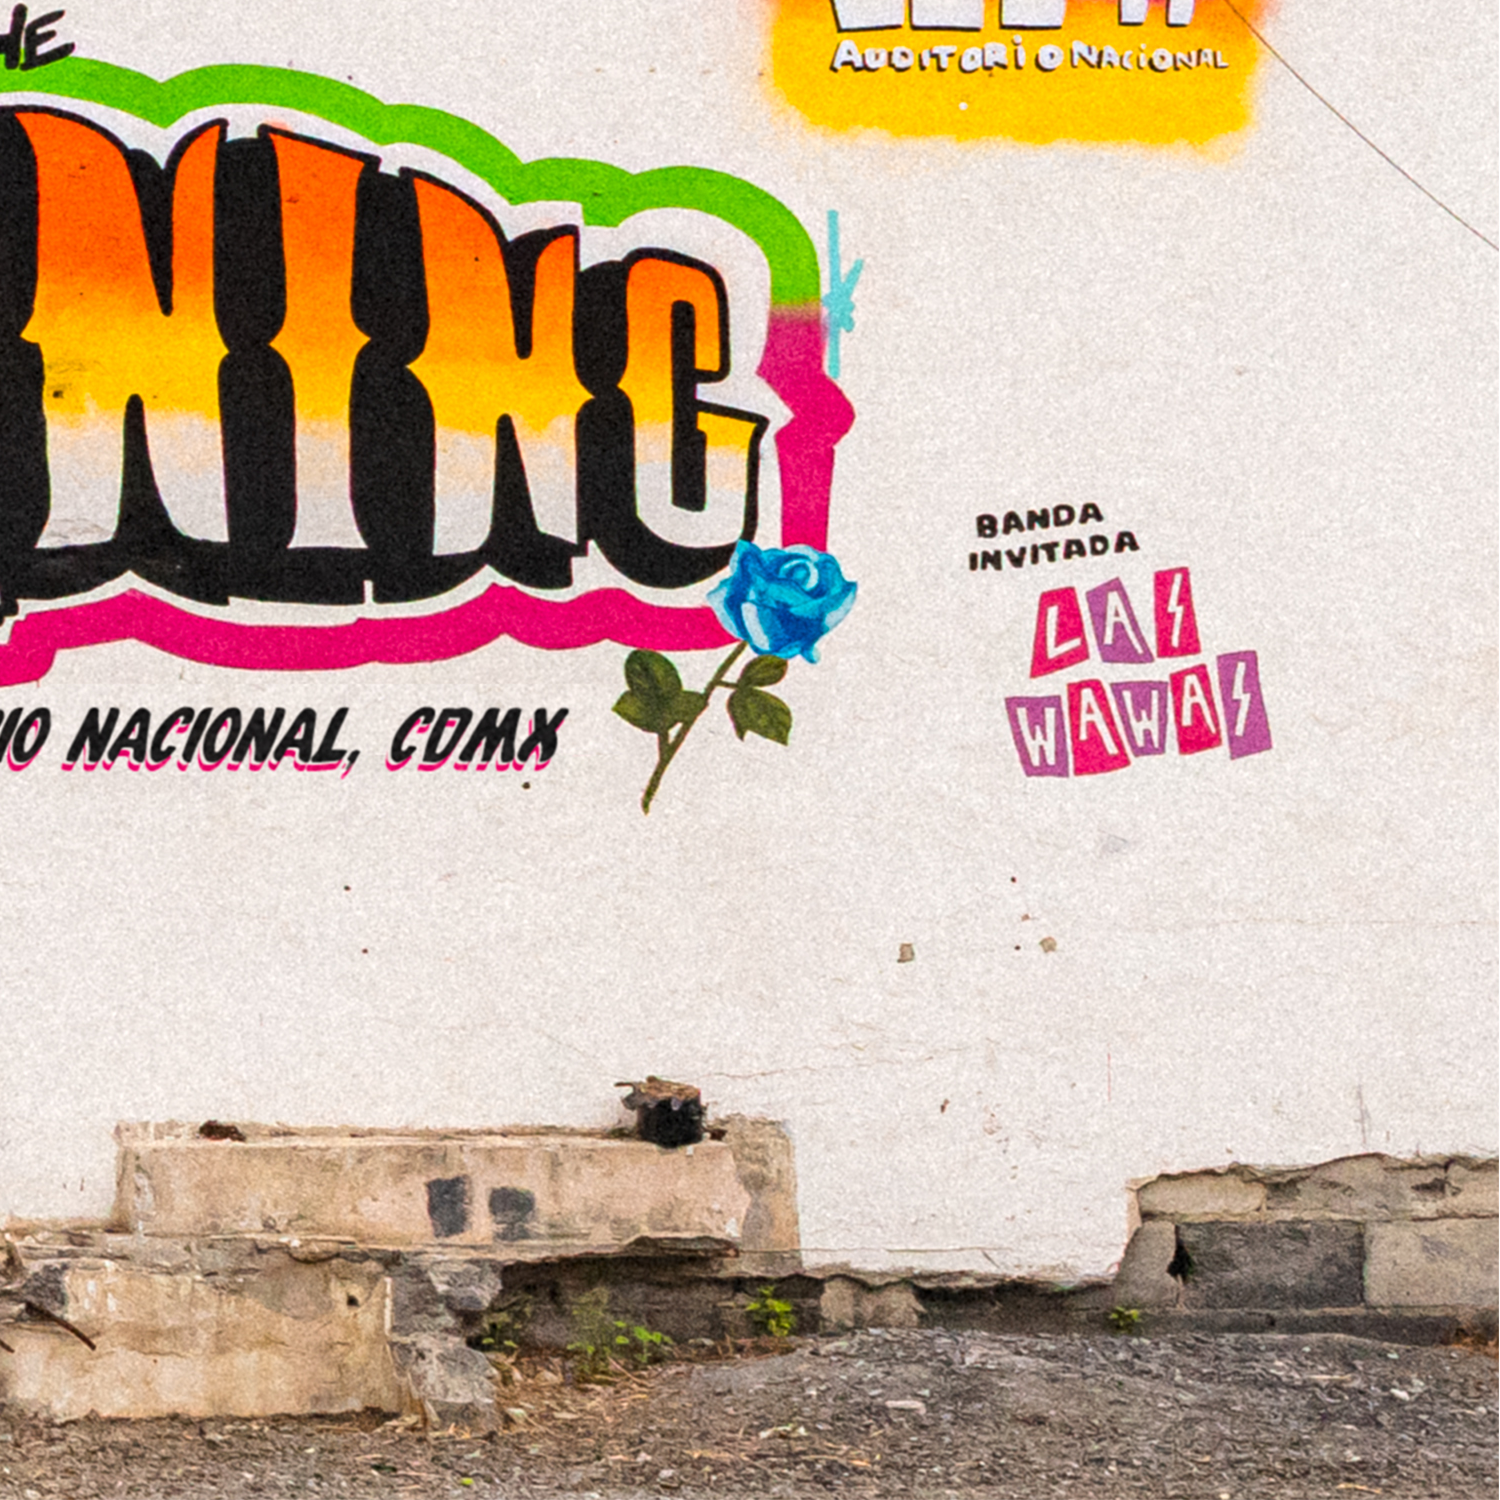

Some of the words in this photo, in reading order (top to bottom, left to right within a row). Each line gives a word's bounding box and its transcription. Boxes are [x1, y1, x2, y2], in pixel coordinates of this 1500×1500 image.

[969, 531, 1139, 570] INVITADA
[976, 503, 1103, 538] BANDA
[1043, 570, 1186, 661] LAS
[61, 707, 360, 779] NACIONAL,
[385, 707, 569, 772] CDMX
[1014, 658, 1252, 769] WAWAS
